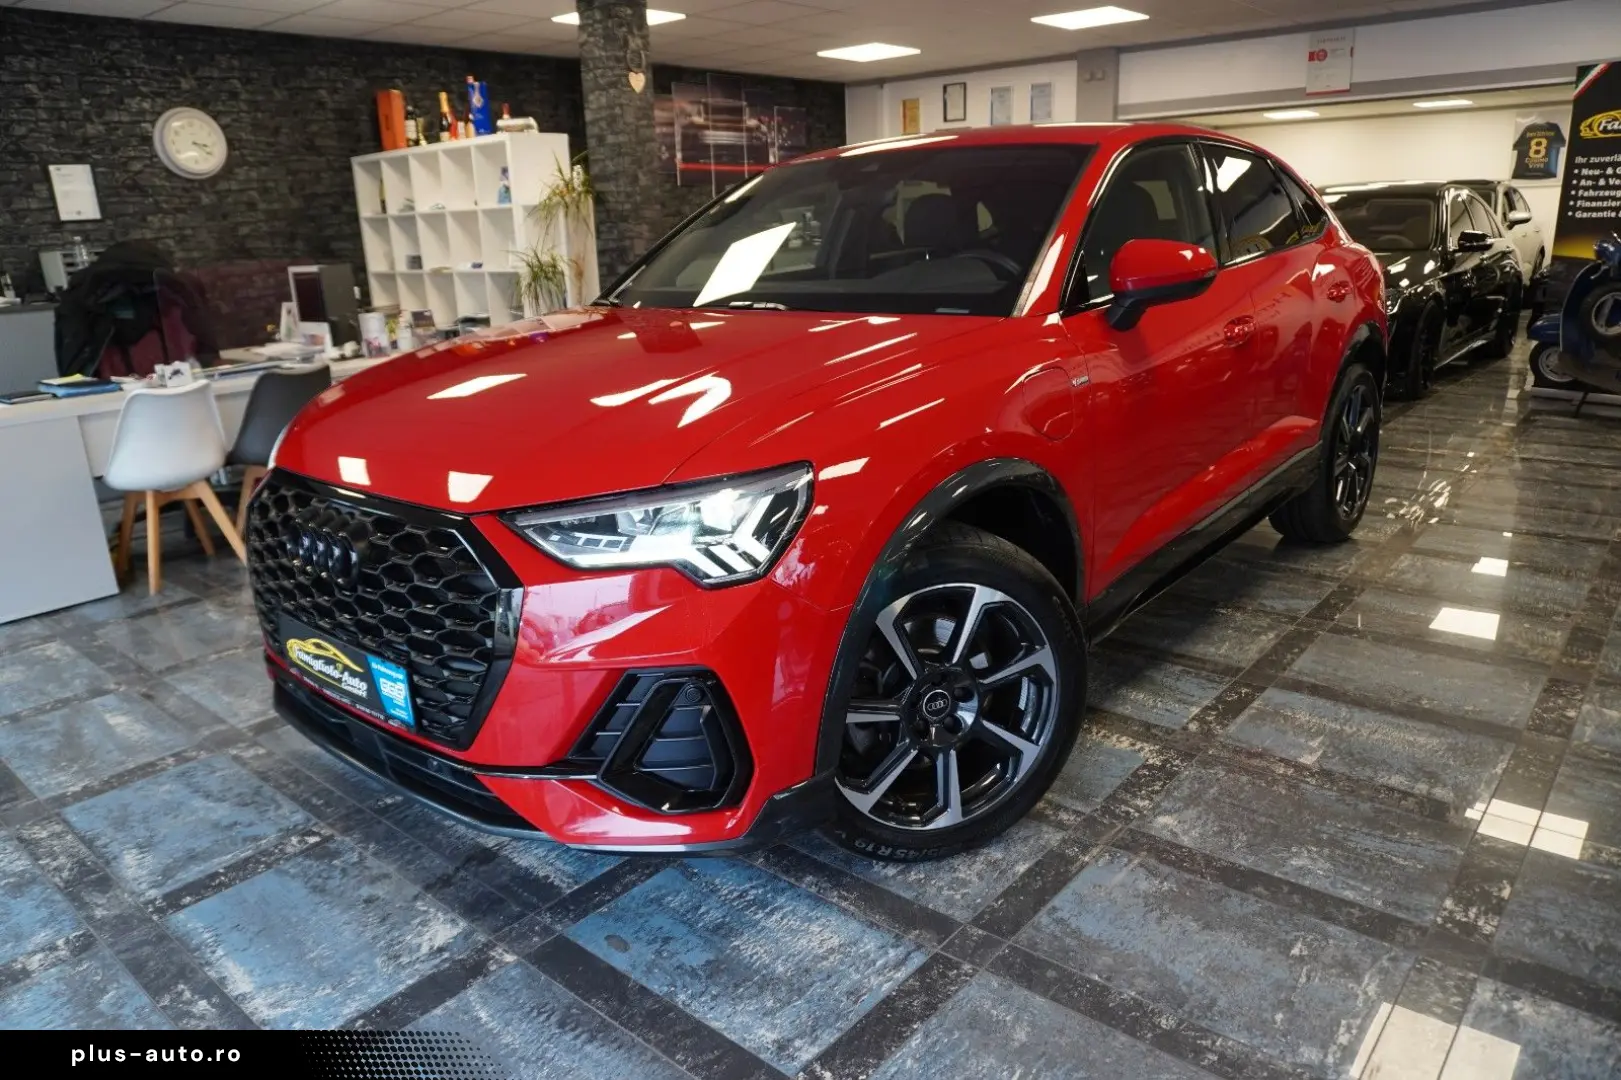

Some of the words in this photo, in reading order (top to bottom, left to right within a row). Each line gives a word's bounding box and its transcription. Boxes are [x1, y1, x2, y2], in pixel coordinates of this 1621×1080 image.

[1529, 138, 1547, 157] 8
[1575, 156, 1588, 164] Ihr
[1580, 168, 1604, 176] Neu-
[1606, 166, 1614, 175] &
[1579, 178, 1596, 186] An-
[1598, 178, 1606, 186] &
[1574, 210, 1617, 219] Garantie
